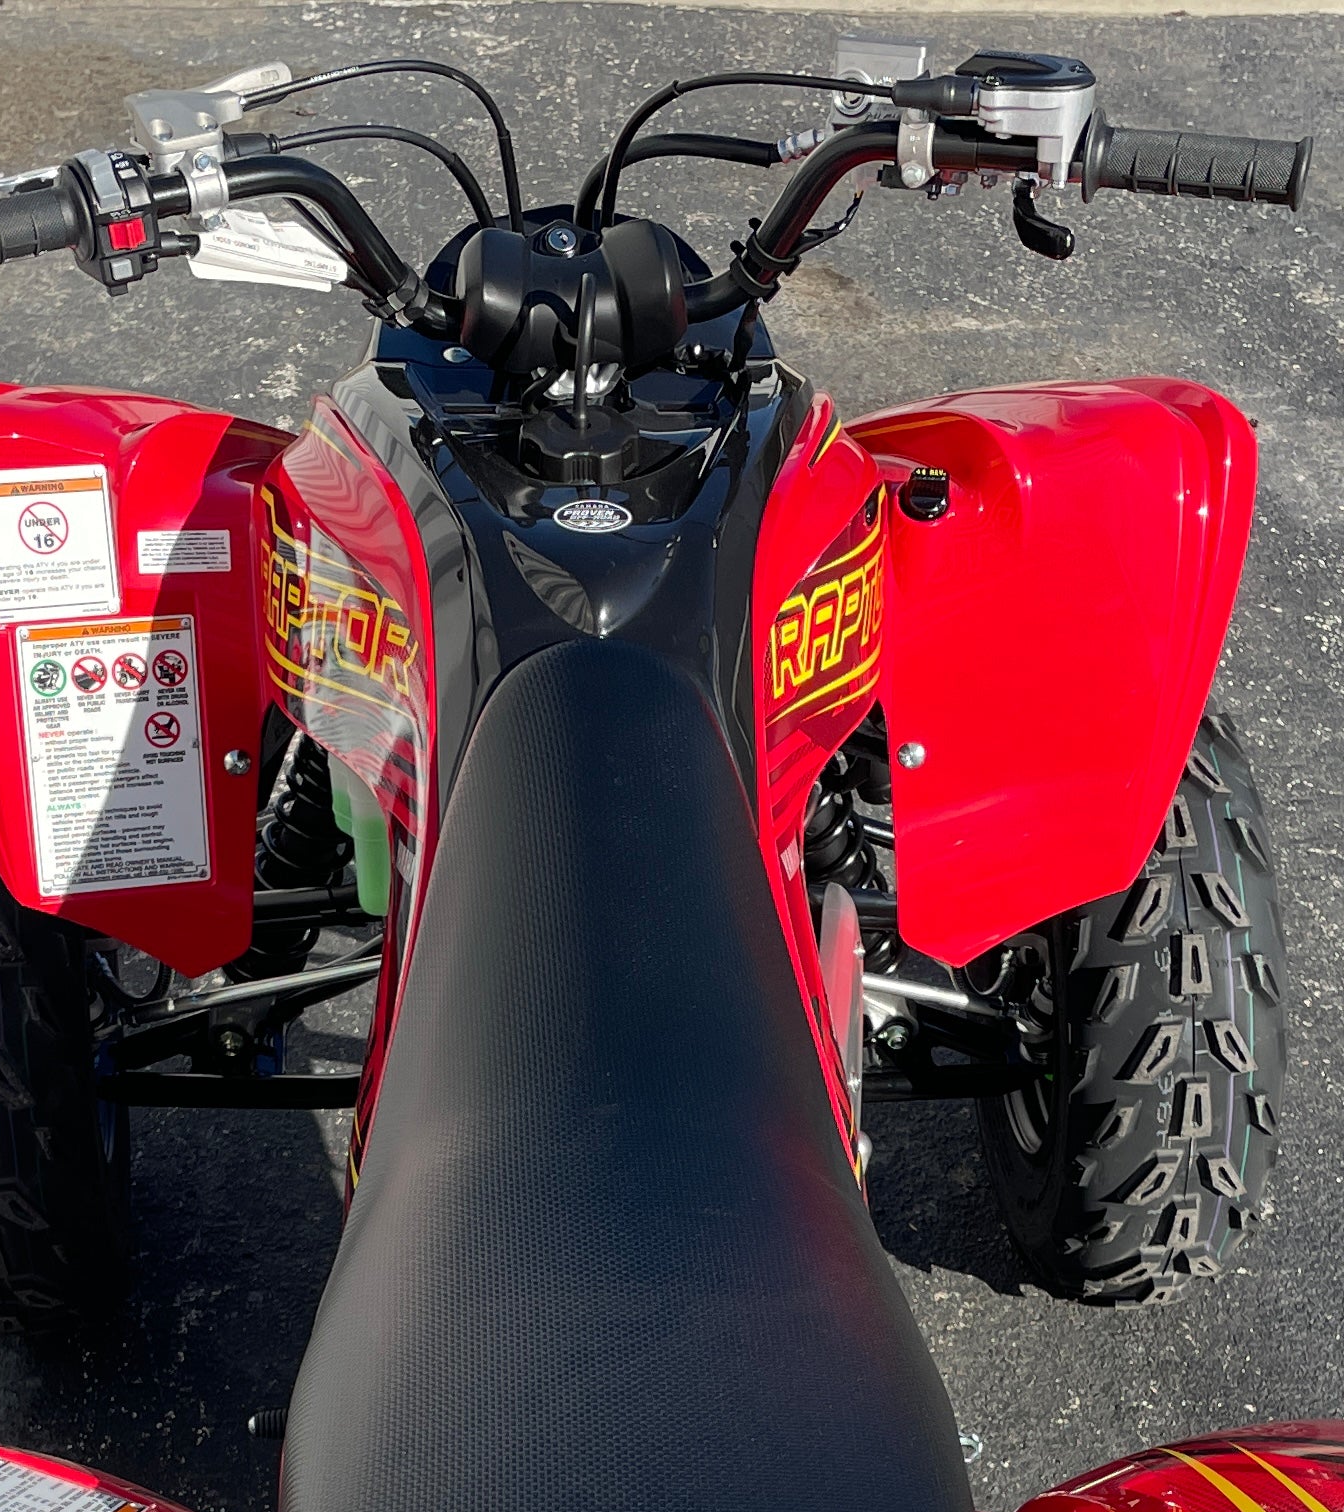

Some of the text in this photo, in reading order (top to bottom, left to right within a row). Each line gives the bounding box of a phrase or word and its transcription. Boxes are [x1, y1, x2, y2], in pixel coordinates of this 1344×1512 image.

[20, 483, 64, 493] WARNING
[24, 517, 61, 528] UNDER
[33, 533, 55, 549] 16
[260, 538, 419, 697] RAPTOR
[91, 624, 132, 635] WARNING
[32, 641, 68, 652] Improper
[118, 636, 140, 644] result
[150, 633, 180, 641] SEVERE
[33, 650, 62, 659] INJURY
[74, 647, 103, 656] DEATH.
[38, 729, 94, 739] NEVER operate
[46, 802, 82, 812] ALWAYS
